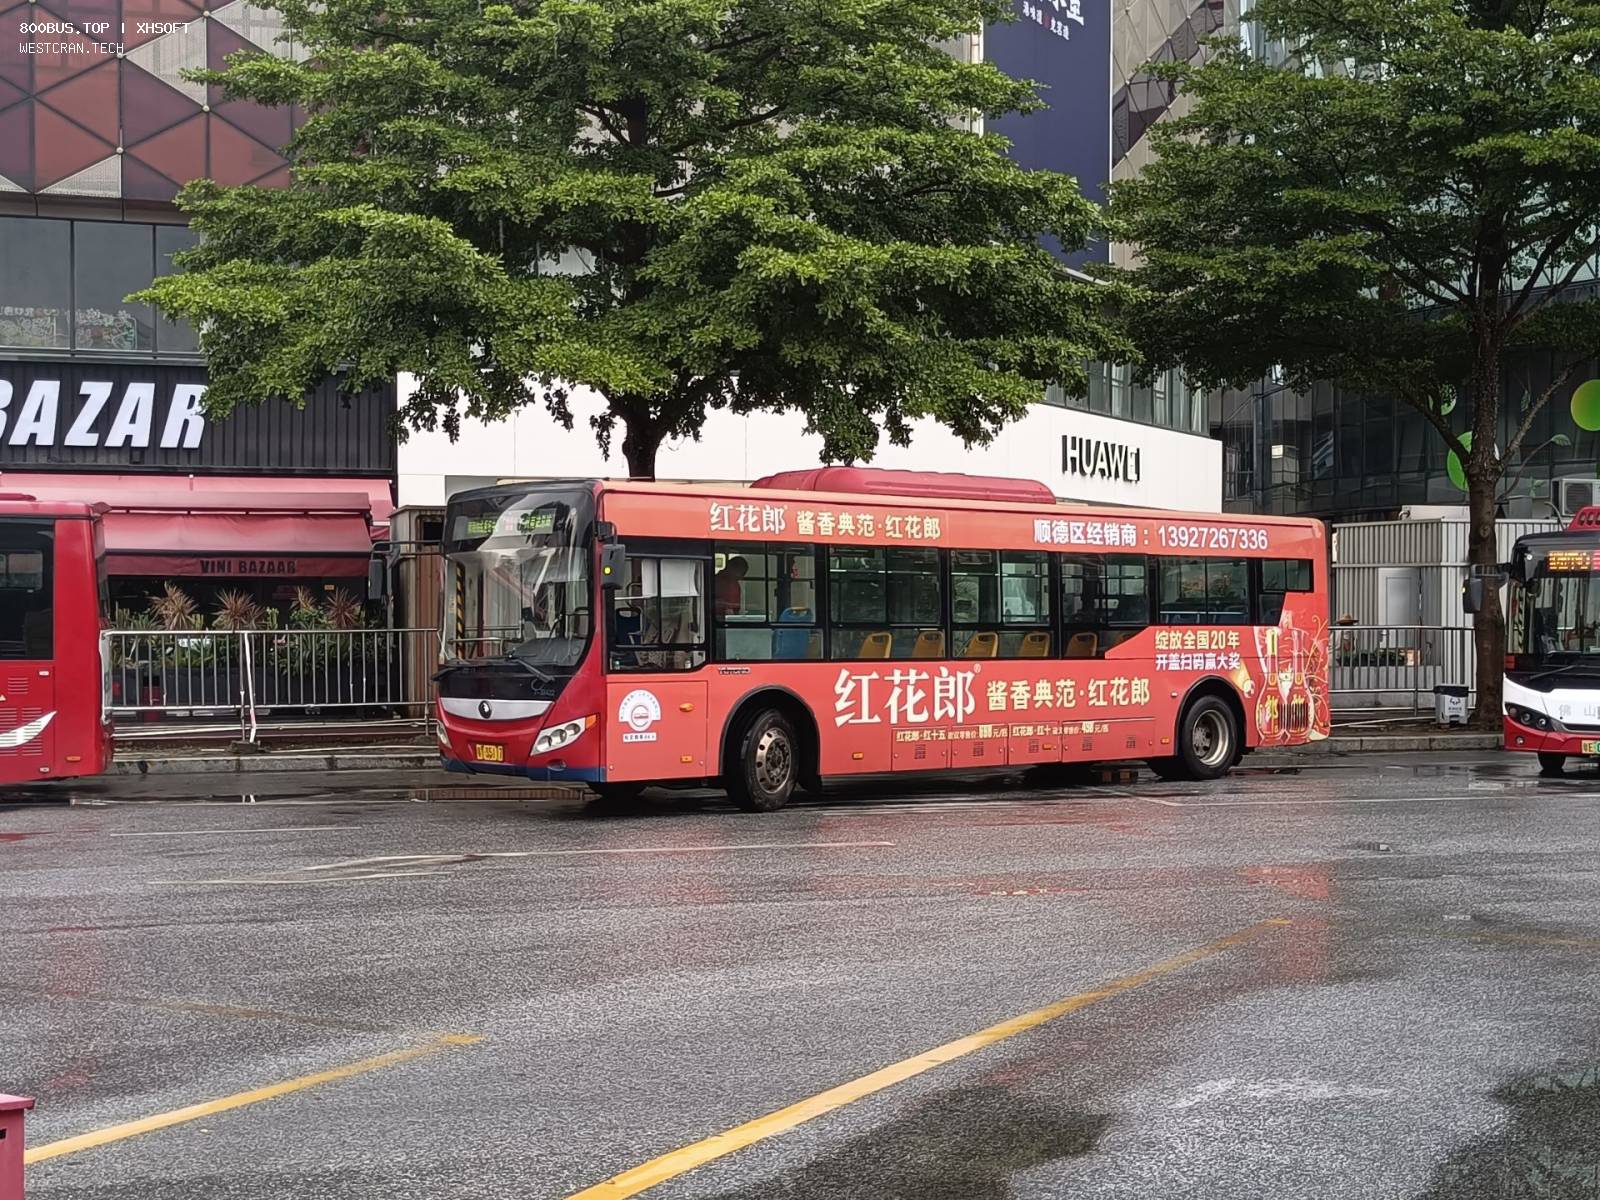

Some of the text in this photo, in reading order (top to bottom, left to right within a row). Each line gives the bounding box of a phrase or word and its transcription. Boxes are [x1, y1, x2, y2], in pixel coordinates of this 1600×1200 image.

[0, 379, 208, 448] AZAR
[709, 502, 941, 539] 红花郎 酱香典范·红花郎
[1158, 525, 1268, 550] 13927267336
[200, 560, 297, 575] VINI BAZAAR
[1155, 630, 1241, 650] 绽放全国20年
[1155, 653, 1241, 671] 开盖扫码赢大奖
[833, 666, 1150, 727] 红花郎 酱香典范·红花郎
